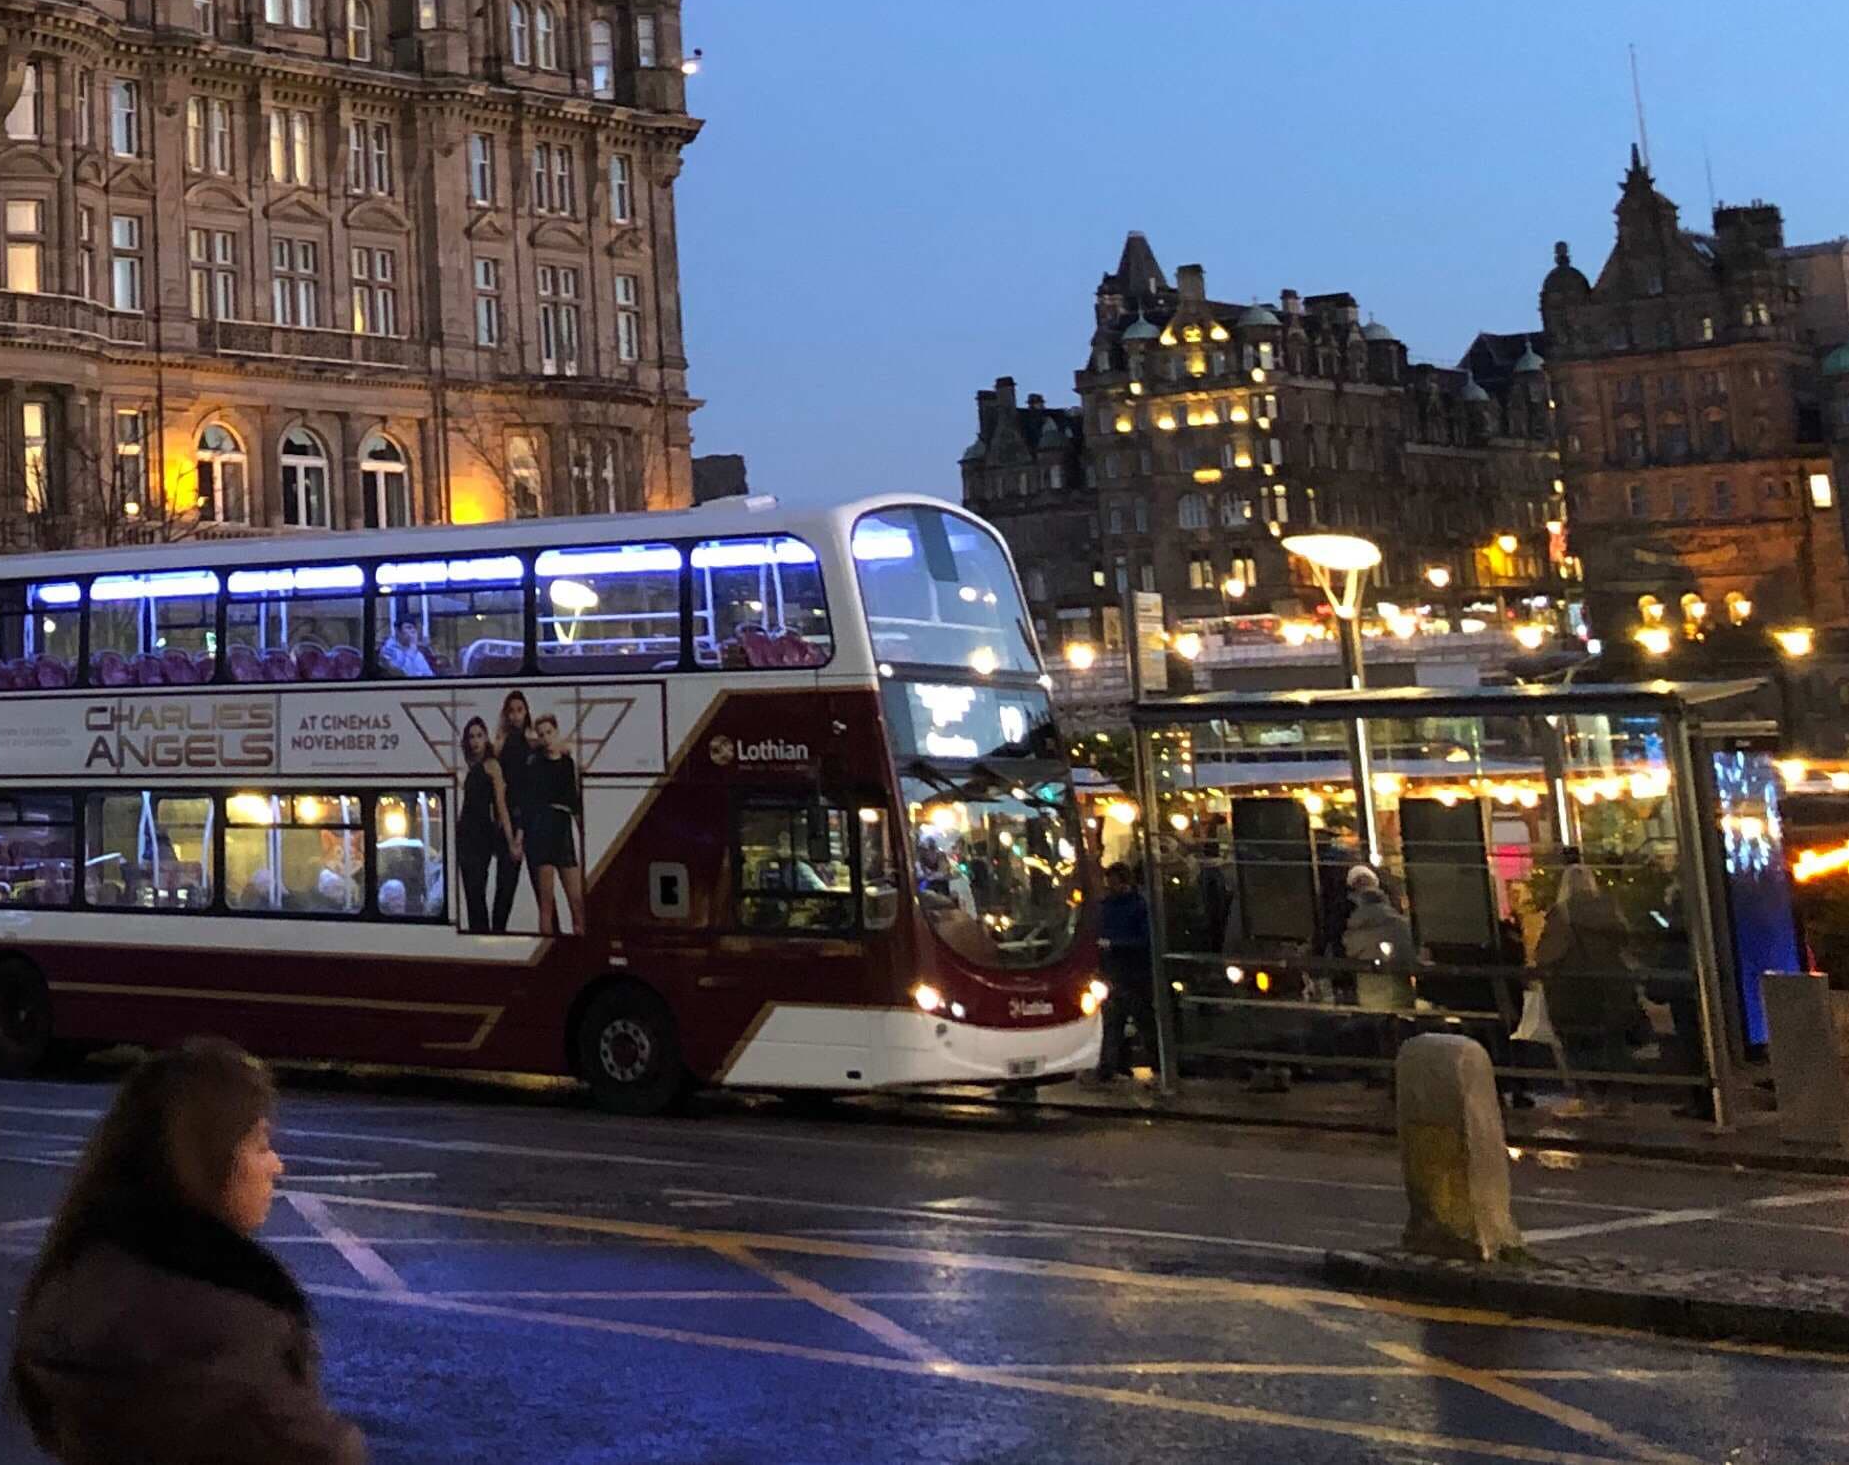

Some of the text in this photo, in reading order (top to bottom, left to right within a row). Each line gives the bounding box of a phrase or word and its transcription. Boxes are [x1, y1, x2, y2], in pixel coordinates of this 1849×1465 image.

[84, 702, 273, 732] CHARLIES
[299, 714, 392, 731] AT CINEMAS
[84, 734, 274, 769] ANGELS
[290, 734, 400, 751] NOVEMBER 29
[736, 738, 809, 761] Lothian
